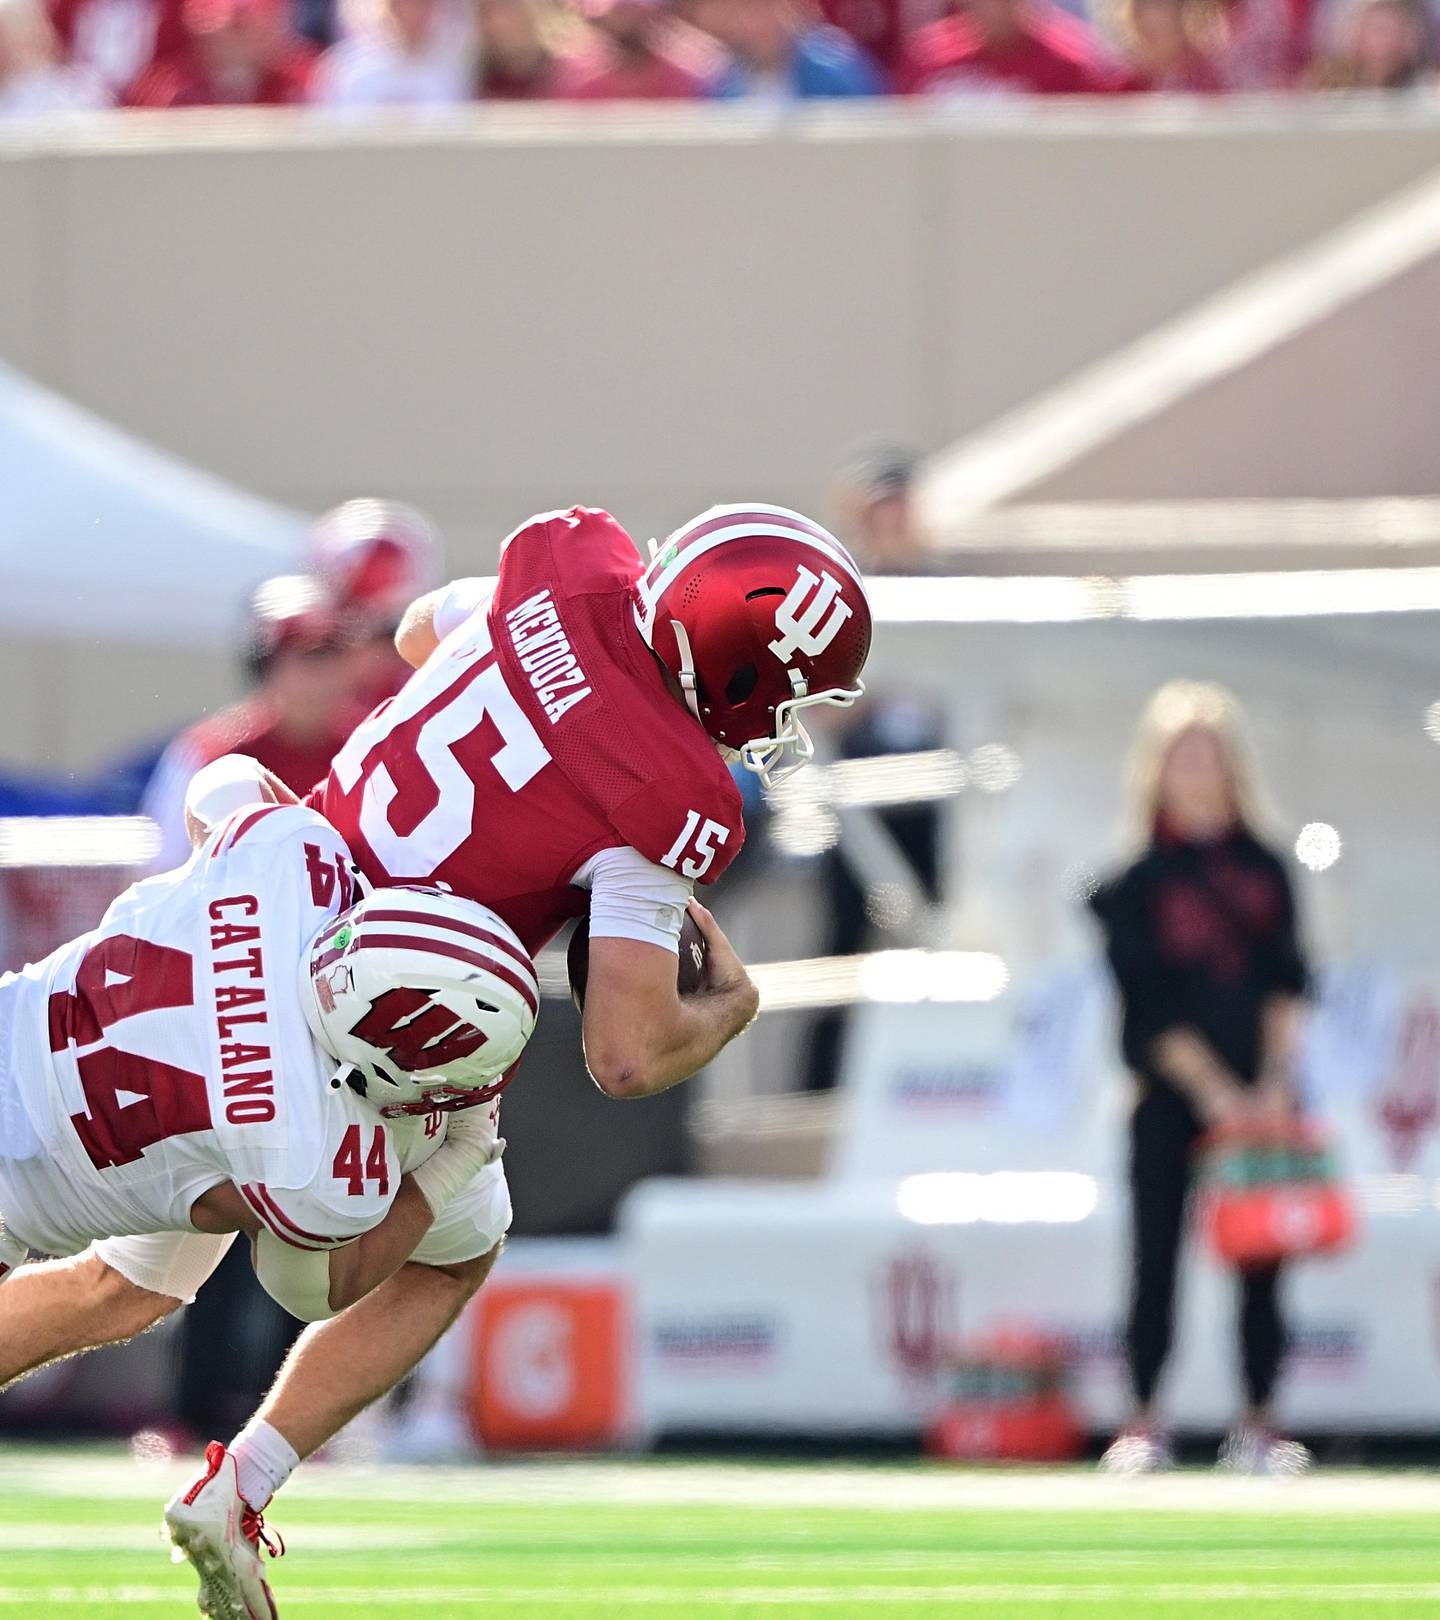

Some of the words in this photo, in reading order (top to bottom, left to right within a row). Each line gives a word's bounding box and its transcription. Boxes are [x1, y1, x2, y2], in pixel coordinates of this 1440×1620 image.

[504, 588, 593, 725] MENDOZA
[331, 603, 553, 878] 15
[660, 808, 730, 880] 15
[48, 933, 215, 1171] 44
[208, 894, 277, 1126] CATALANO
[347, 986, 490, 1073] W
[332, 1124, 390, 1196] 44
